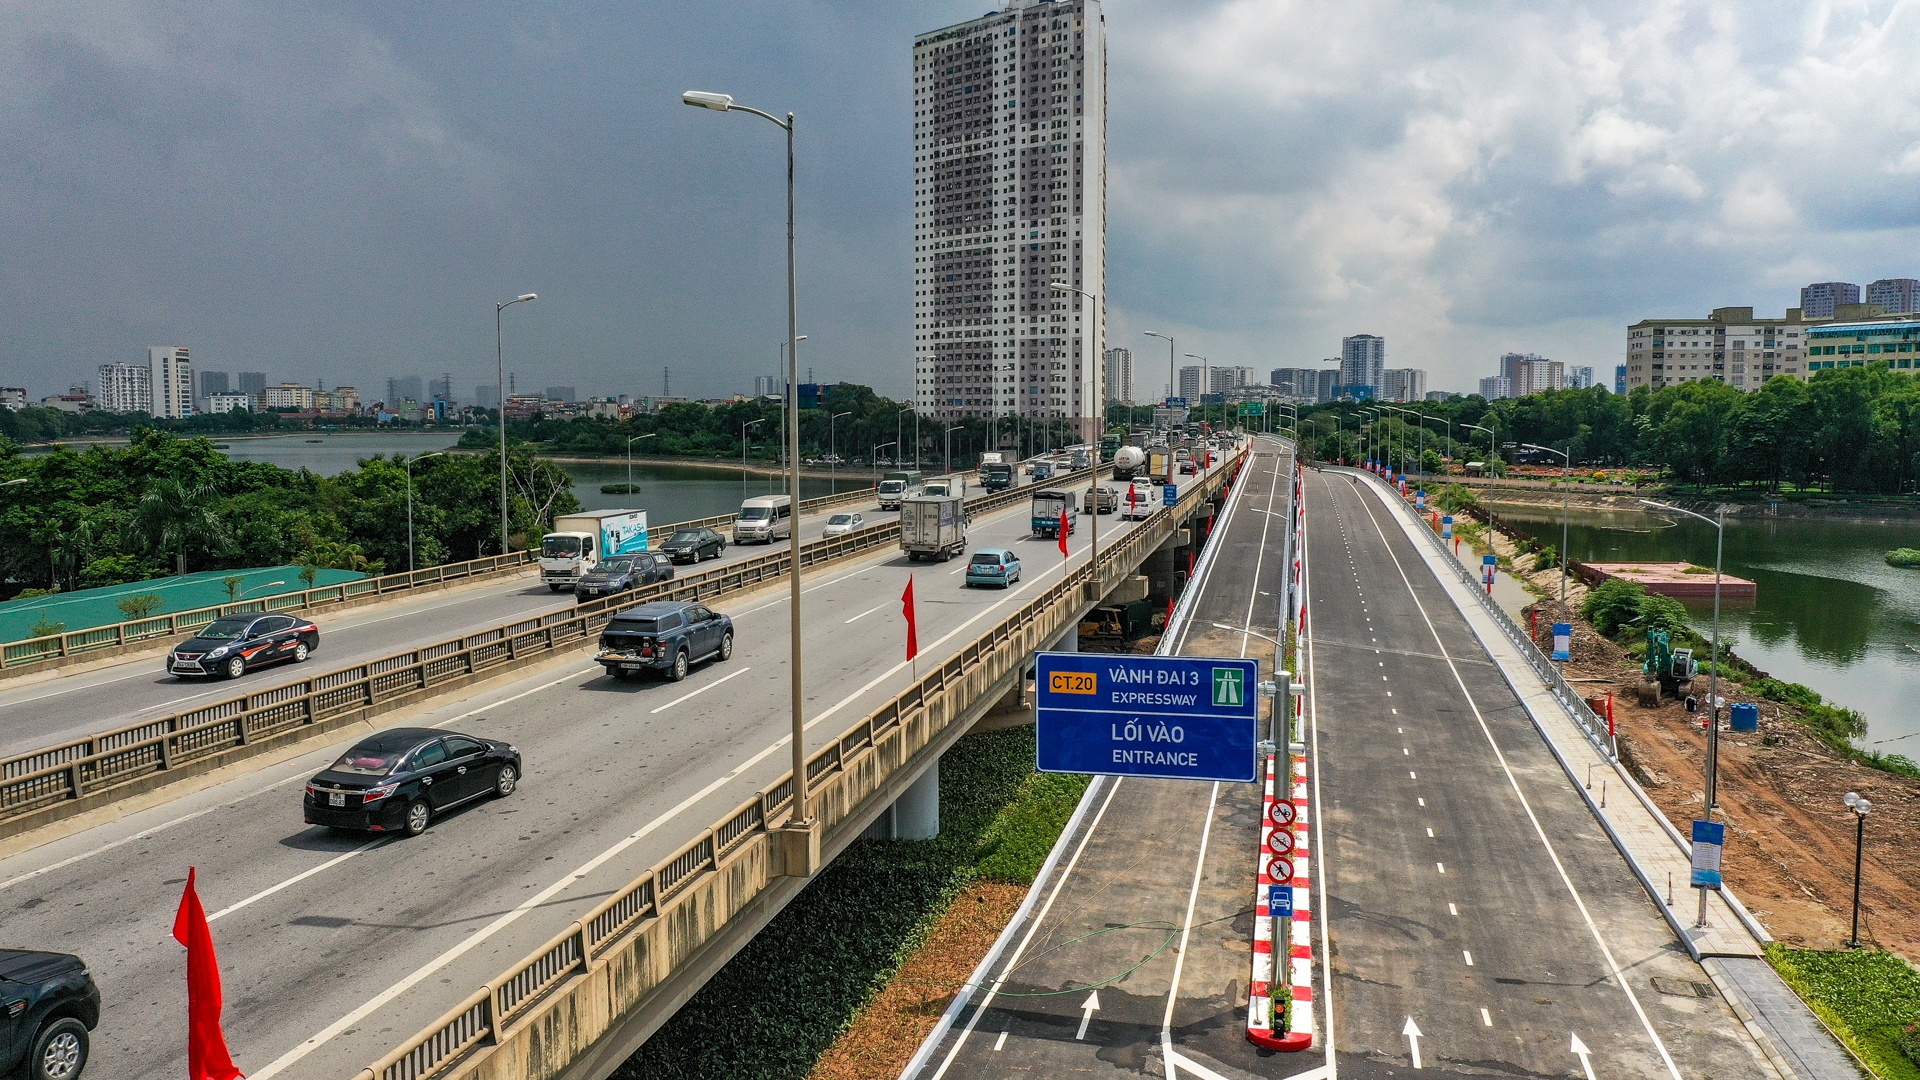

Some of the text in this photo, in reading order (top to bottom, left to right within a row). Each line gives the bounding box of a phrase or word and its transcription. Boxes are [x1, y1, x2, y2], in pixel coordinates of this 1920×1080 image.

[622, 523, 644, 534] TAKASA
[1052, 675, 1093, 691] CT.20
[1109, 665, 1199, 686] VÀNH ĐAI 3
[1112, 691, 1197, 706] EXPRESSWAY
[1111, 717, 1184, 743] LỐI VÀO
[1112, 749, 1198, 767] ENTRANCE
